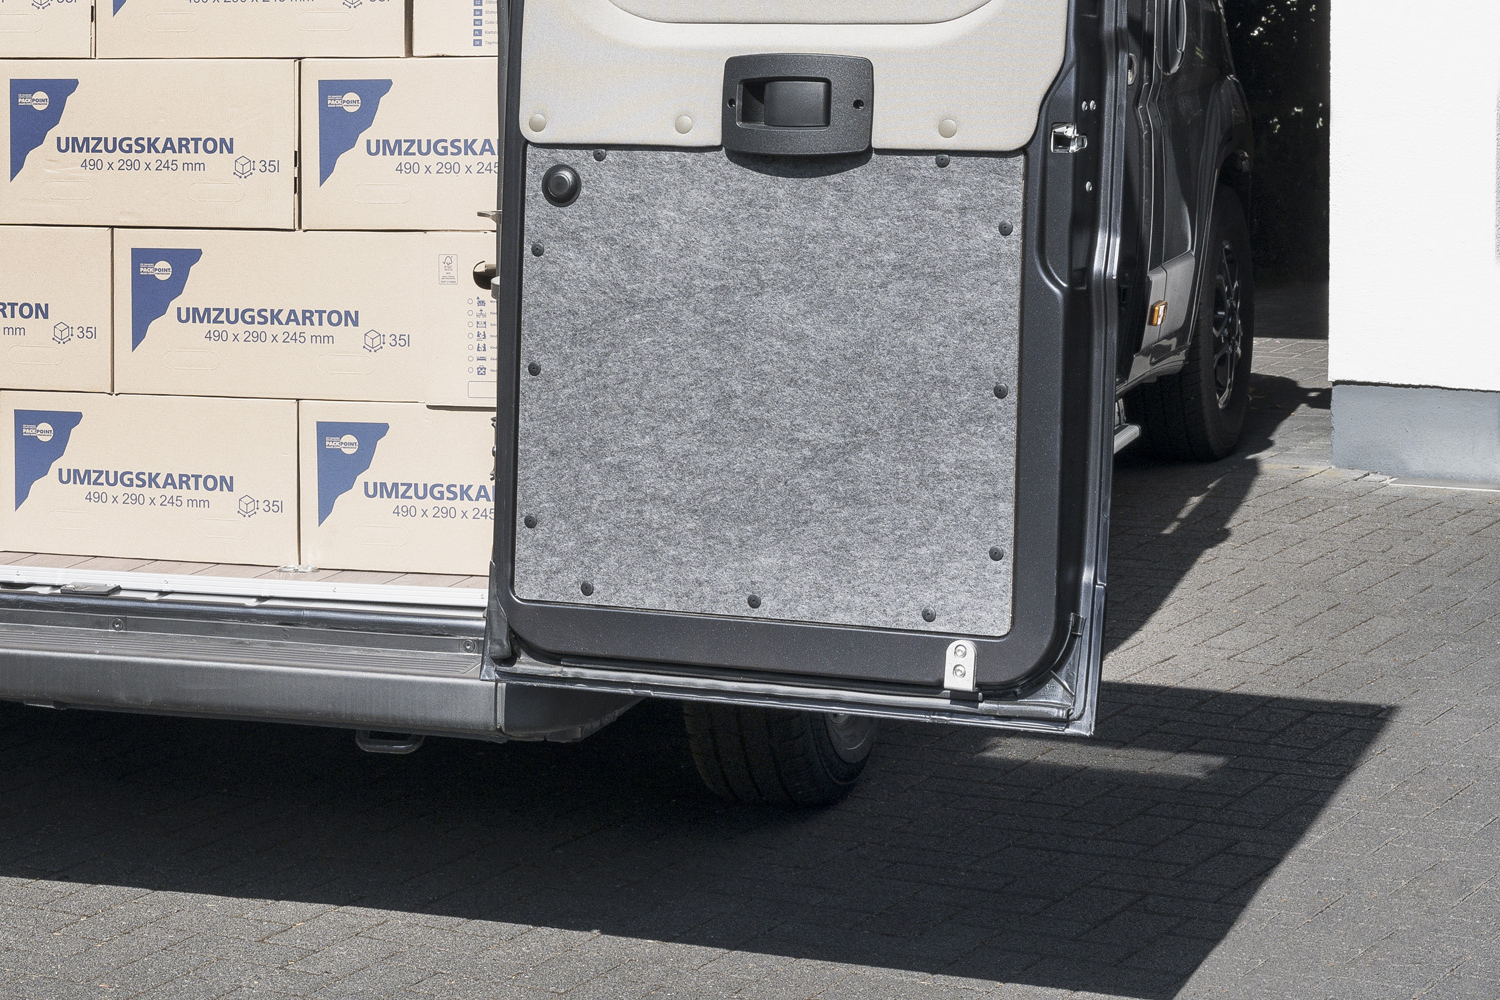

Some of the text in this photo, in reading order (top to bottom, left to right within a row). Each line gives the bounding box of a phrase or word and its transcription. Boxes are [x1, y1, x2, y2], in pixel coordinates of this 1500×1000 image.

[57, 137, 233, 153] UMZUGSKARTON
[366, 138, 498, 156] UMZUGSKA
[81, 159, 205, 171] 490 x 290 x 245 mm
[396, 162, 420, 174] 490
[425, 165, 431, 174] x
[436, 162, 460, 174] 290
[465, 165, 472, 174] x
[177, 307, 359, 327] UMZUGSKARTON
[3, 326, 25, 336] mm
[205, 330, 334, 344] 490 x 290 x 245 mm
[58, 468, 233, 492] UMZUGSKARTON
[85, 491, 209, 508] 490 x 290 x 245 mm
[364, 481, 495, 502] UMZUGSKA
[393, 504, 416, 517] 490
[421, 509, 428, 518] x
[433, 506, 456, 518] 290
[461, 511, 468, 519] x
